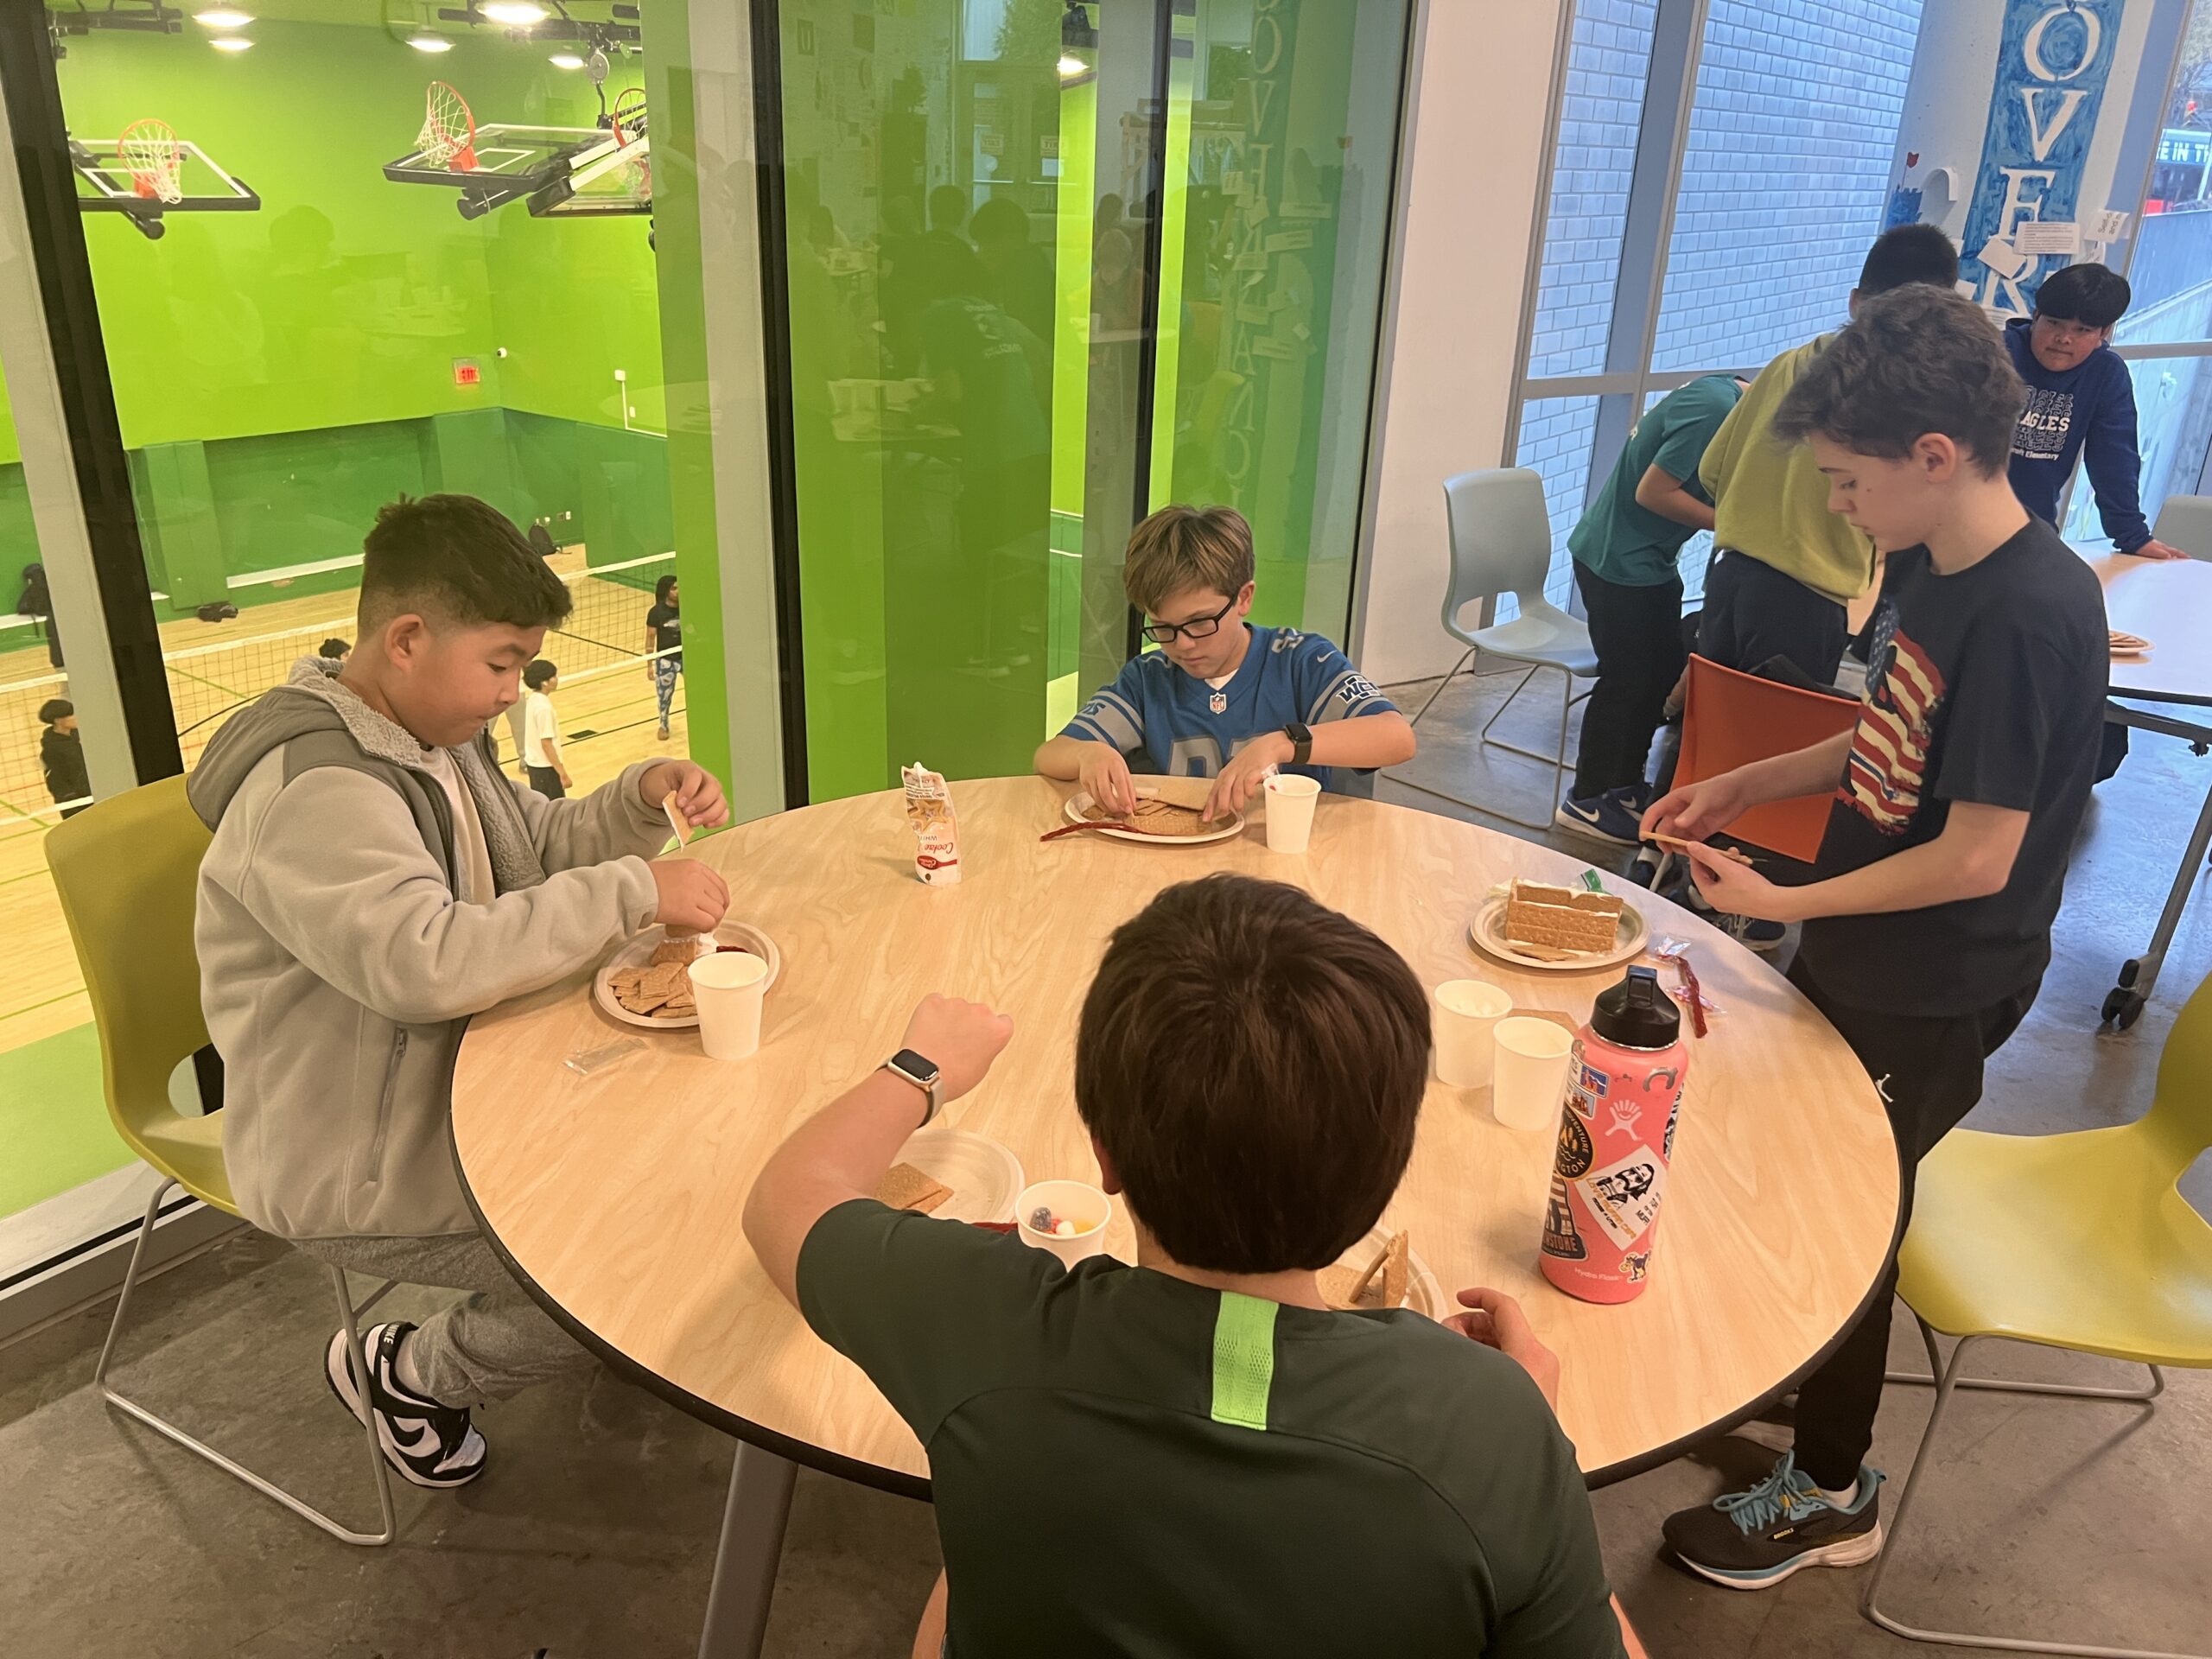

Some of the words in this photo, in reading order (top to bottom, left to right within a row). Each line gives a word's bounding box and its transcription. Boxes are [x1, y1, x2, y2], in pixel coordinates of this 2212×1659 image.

[1980, 0, 2101, 318] OVER
[2171, 142, 2190, 162] IN
[2019, 410, 2070, 432] AGLES
[384, 1324, 400, 1344] NIKE
